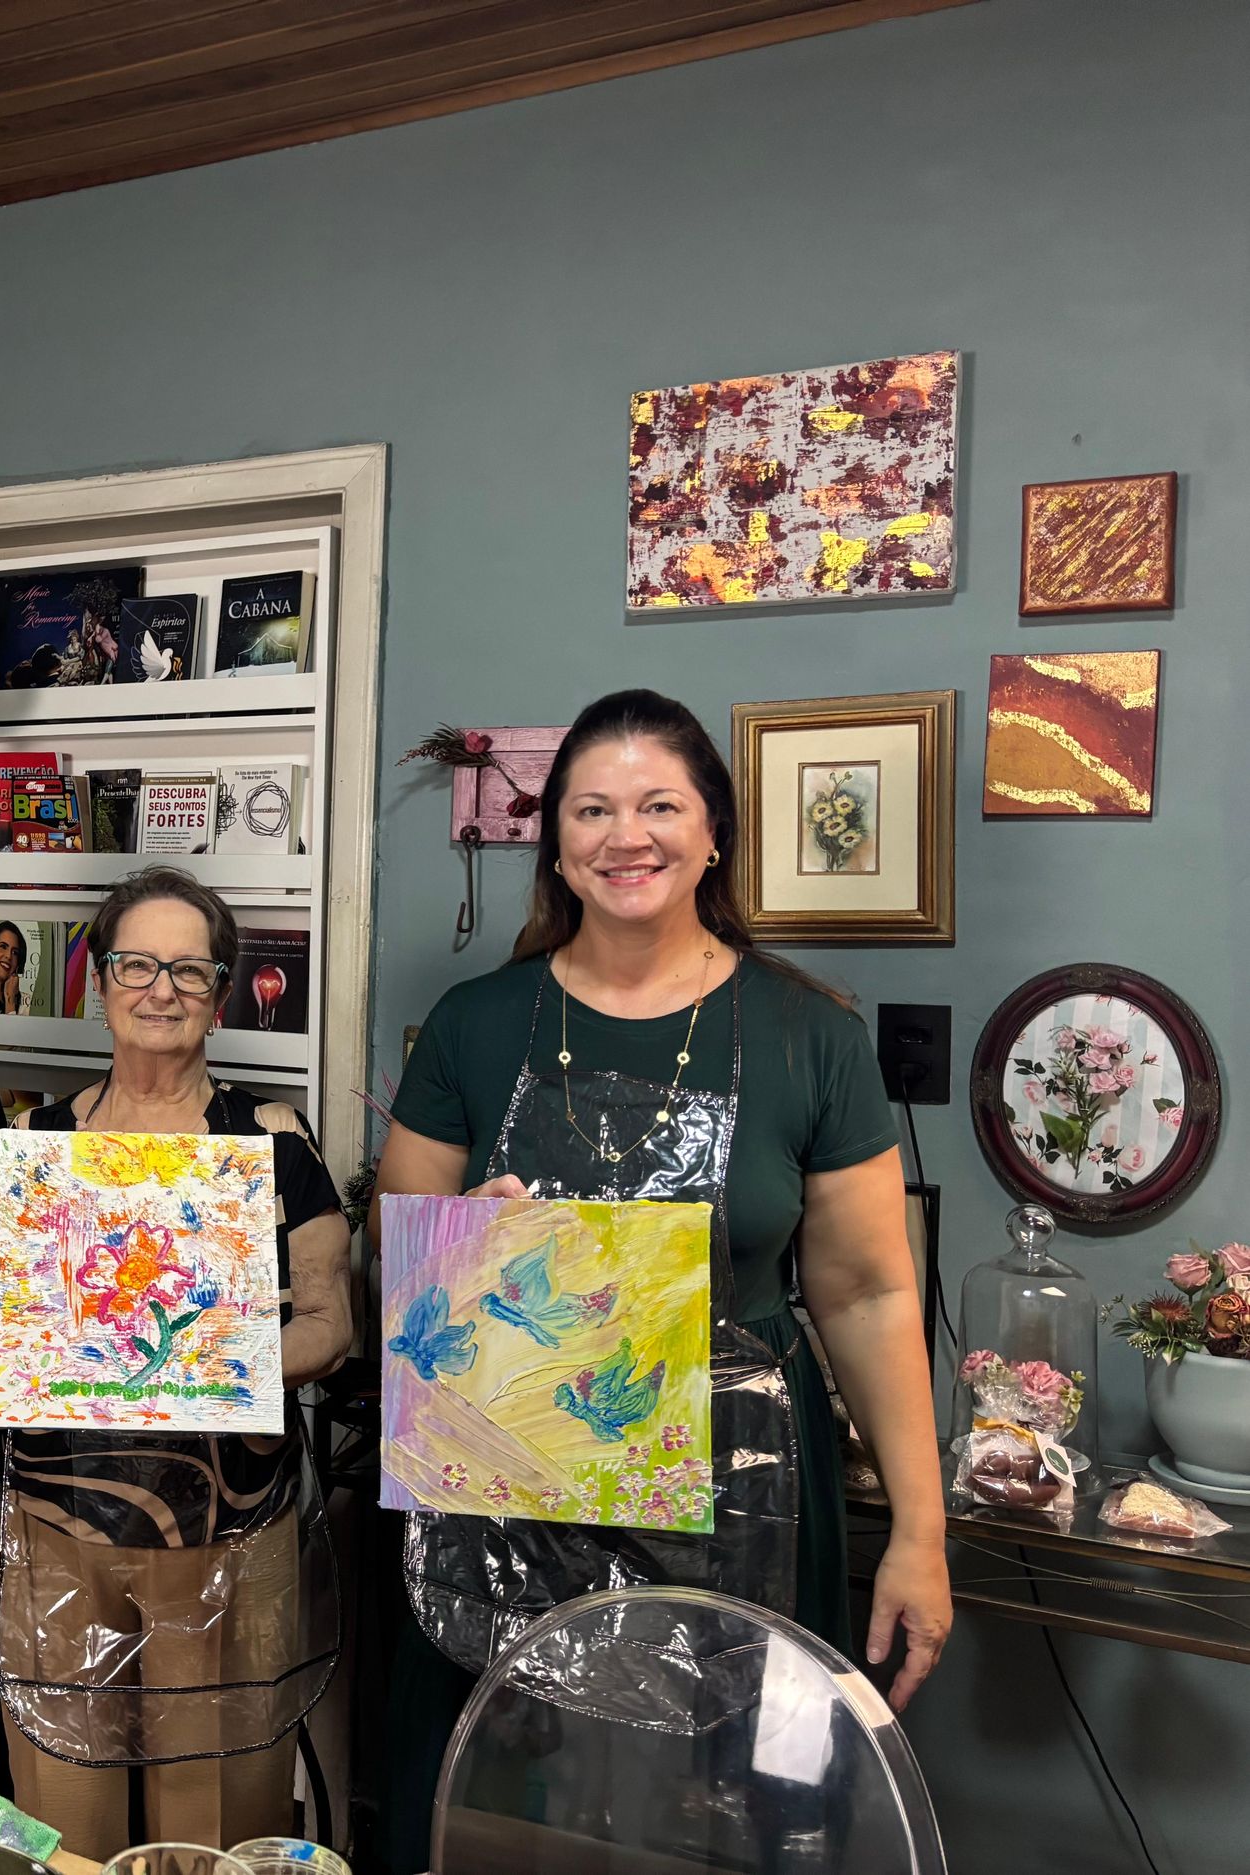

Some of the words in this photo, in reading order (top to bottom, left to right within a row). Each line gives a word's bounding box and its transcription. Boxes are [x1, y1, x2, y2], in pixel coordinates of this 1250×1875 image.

[13, 585, 50, 602] Music
[256, 588, 265, 600] A
[228, 600, 292, 619] CABANA
[17, 611, 78, 630] Romancing
[149, 788, 207, 799] DESCUBRA
[13, 793, 79, 819] Brasil
[148, 802, 171, 811] SEUS
[174, 801, 206, 811] PONTOS
[147, 813, 206, 828] FORTES
